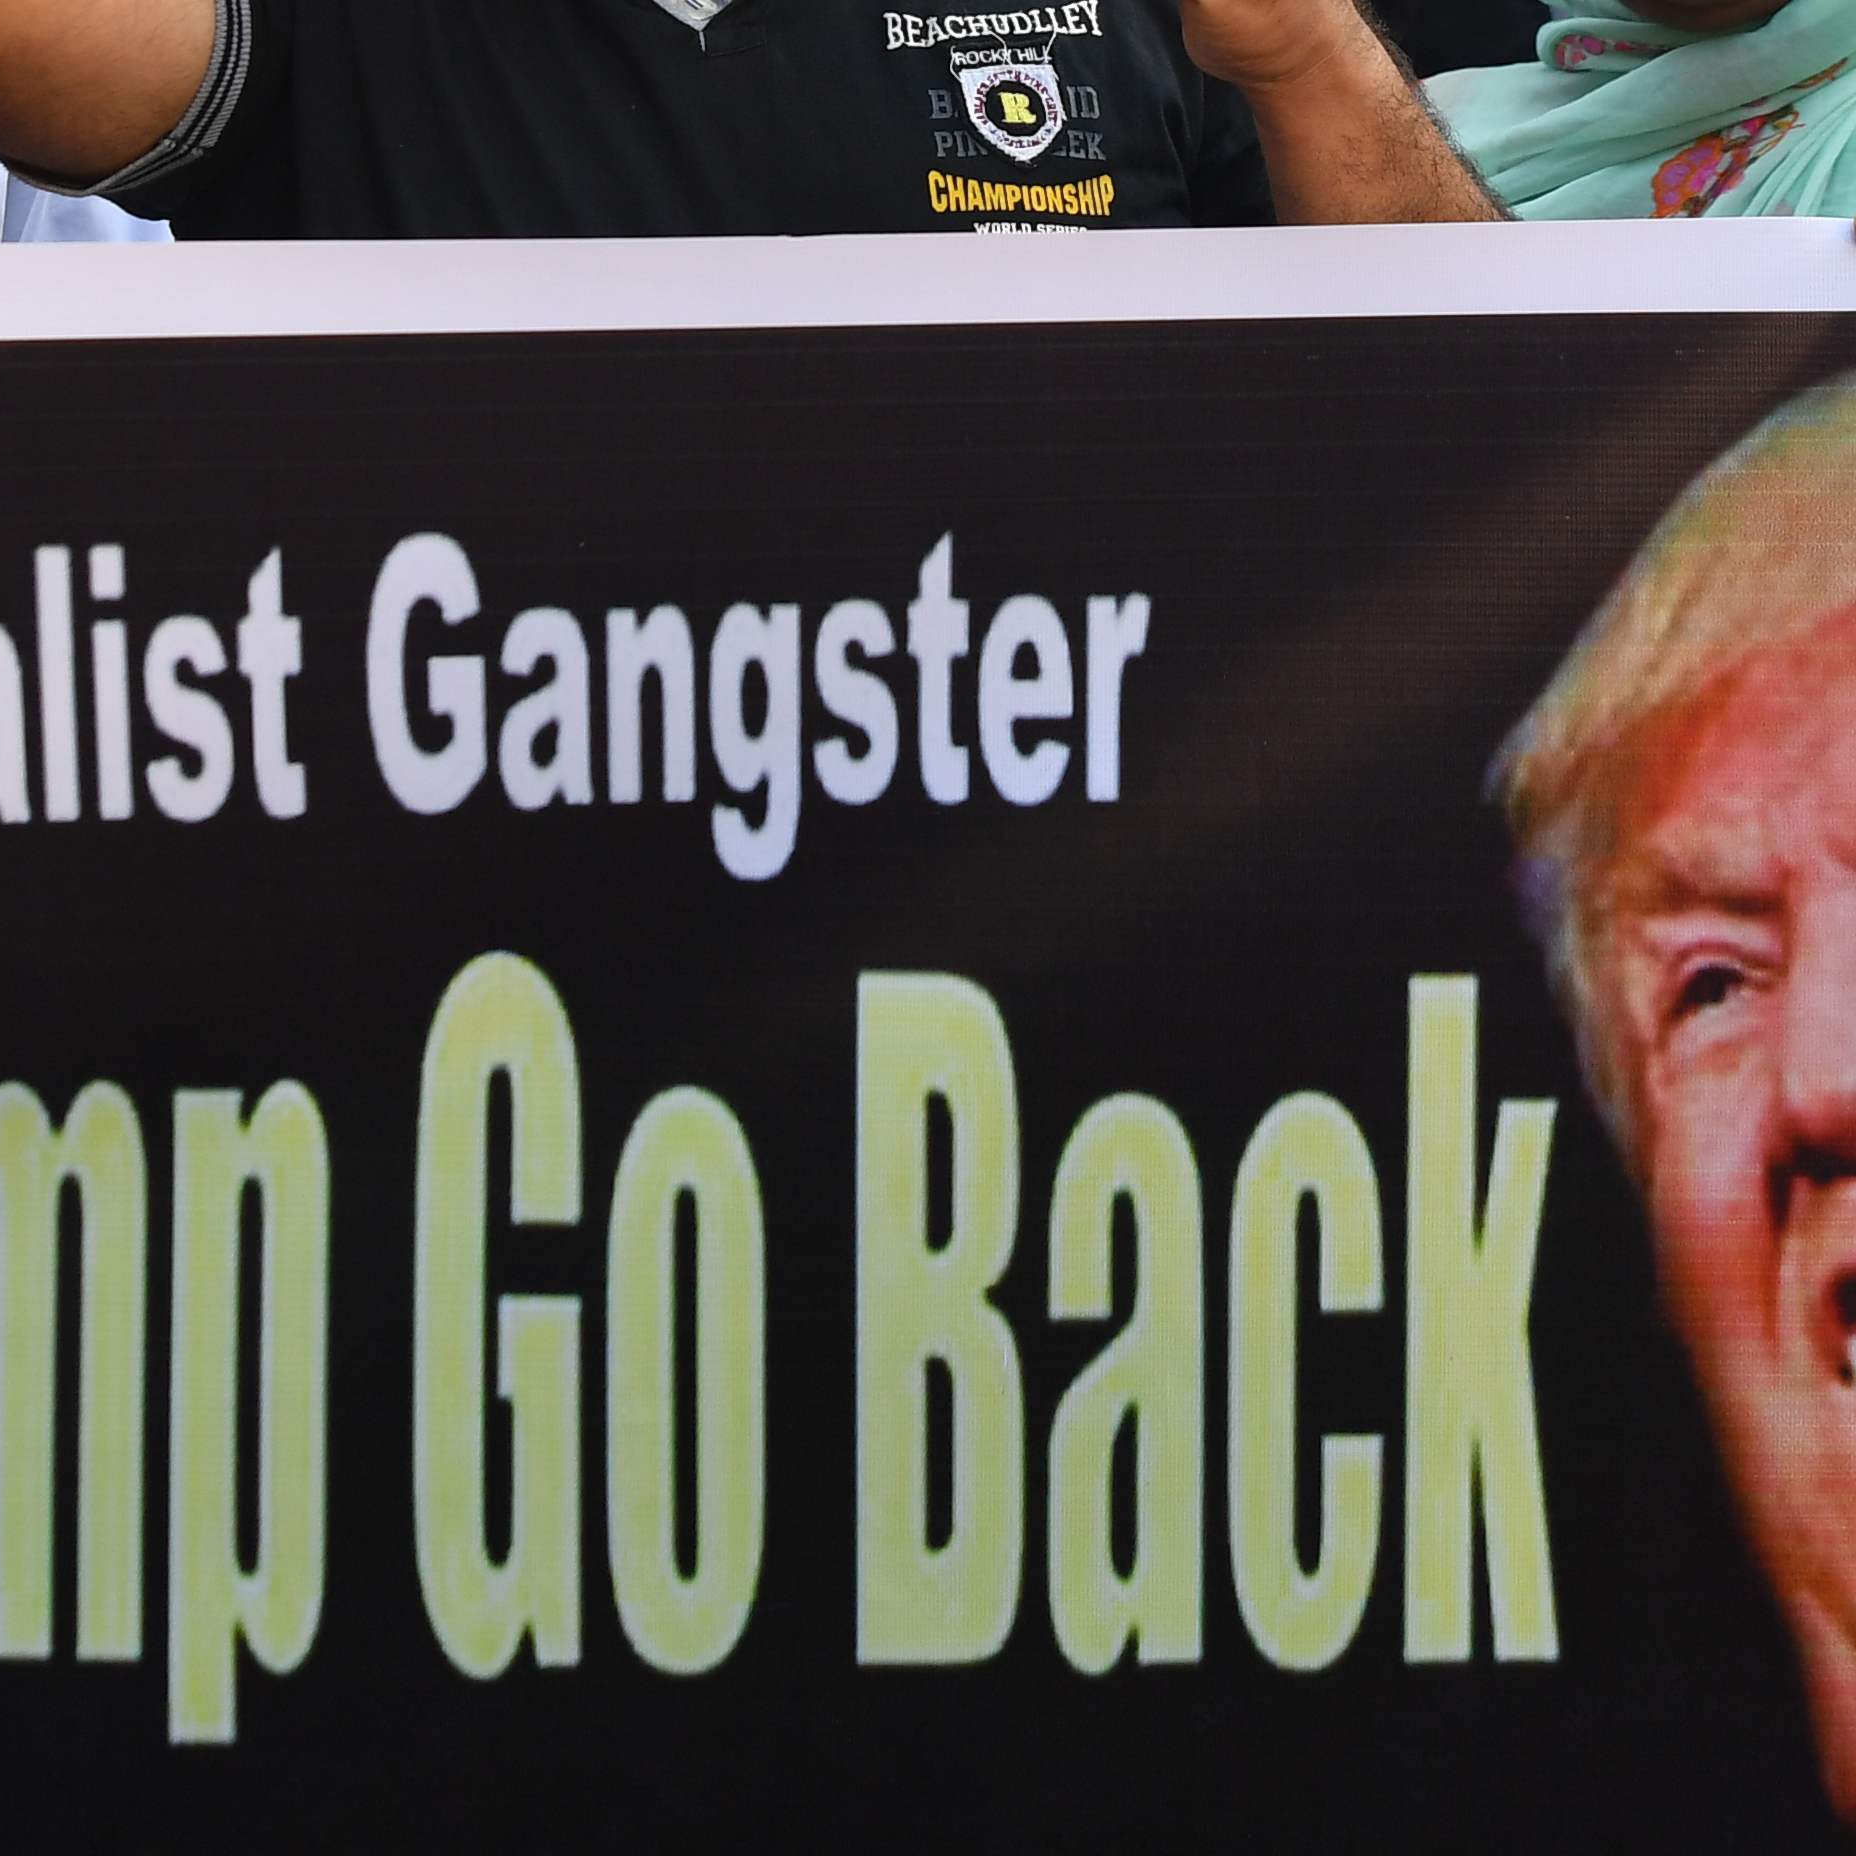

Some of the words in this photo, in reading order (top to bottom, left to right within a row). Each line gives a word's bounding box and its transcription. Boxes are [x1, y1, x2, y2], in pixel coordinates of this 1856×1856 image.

[928, 170, 1115, 217] CHAMPIONSHIP
[998, 91, 1036, 125] R
[367, 534, 1150, 881] Gangster
[414, 952, 765, 1679] Go
[855, 972, 1558, 1676] Back
